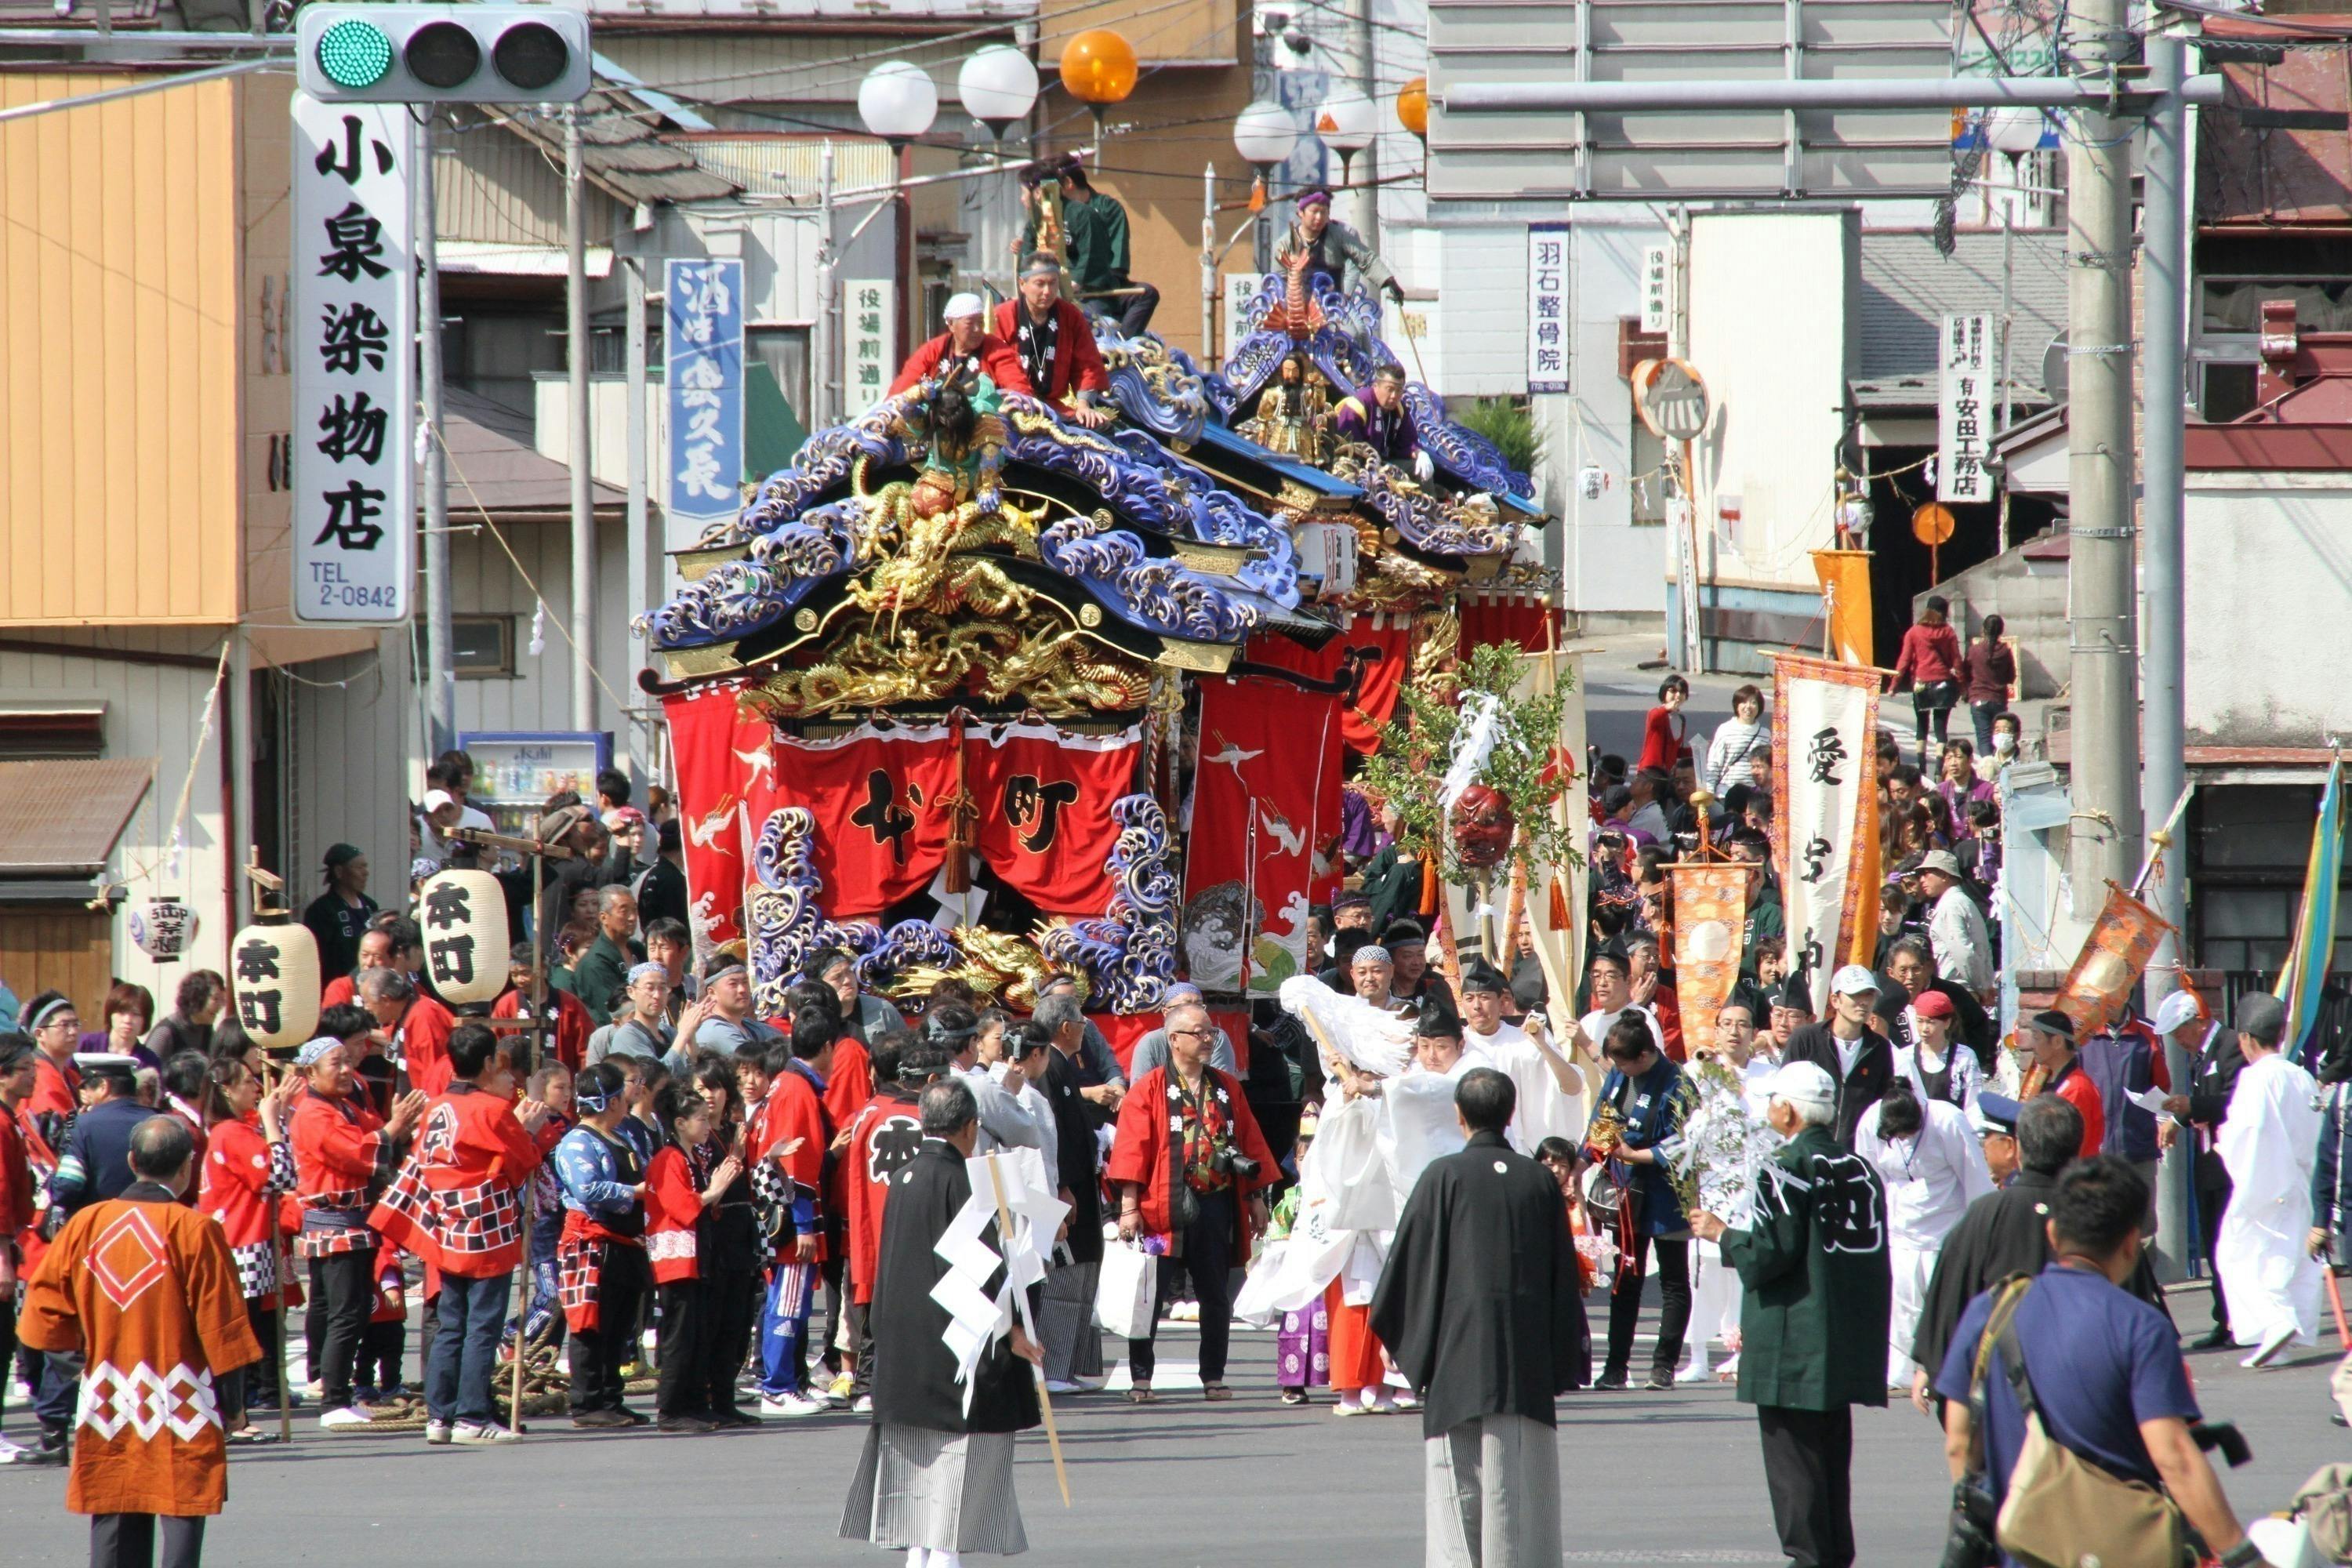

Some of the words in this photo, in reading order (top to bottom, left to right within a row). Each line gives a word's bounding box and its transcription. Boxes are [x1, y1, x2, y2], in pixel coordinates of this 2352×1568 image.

[312, 115, 394, 551] 小泉染物店
[858, 289, 880, 407] 役場前通り
[1537, 242, 1560, 372] 羽石整骨院
[310, 562, 350, 583] TEL
[320, 585, 396, 608] 2-0842
[426, 882, 474, 984] 本町
[238, 938, 281, 1034] 本町
